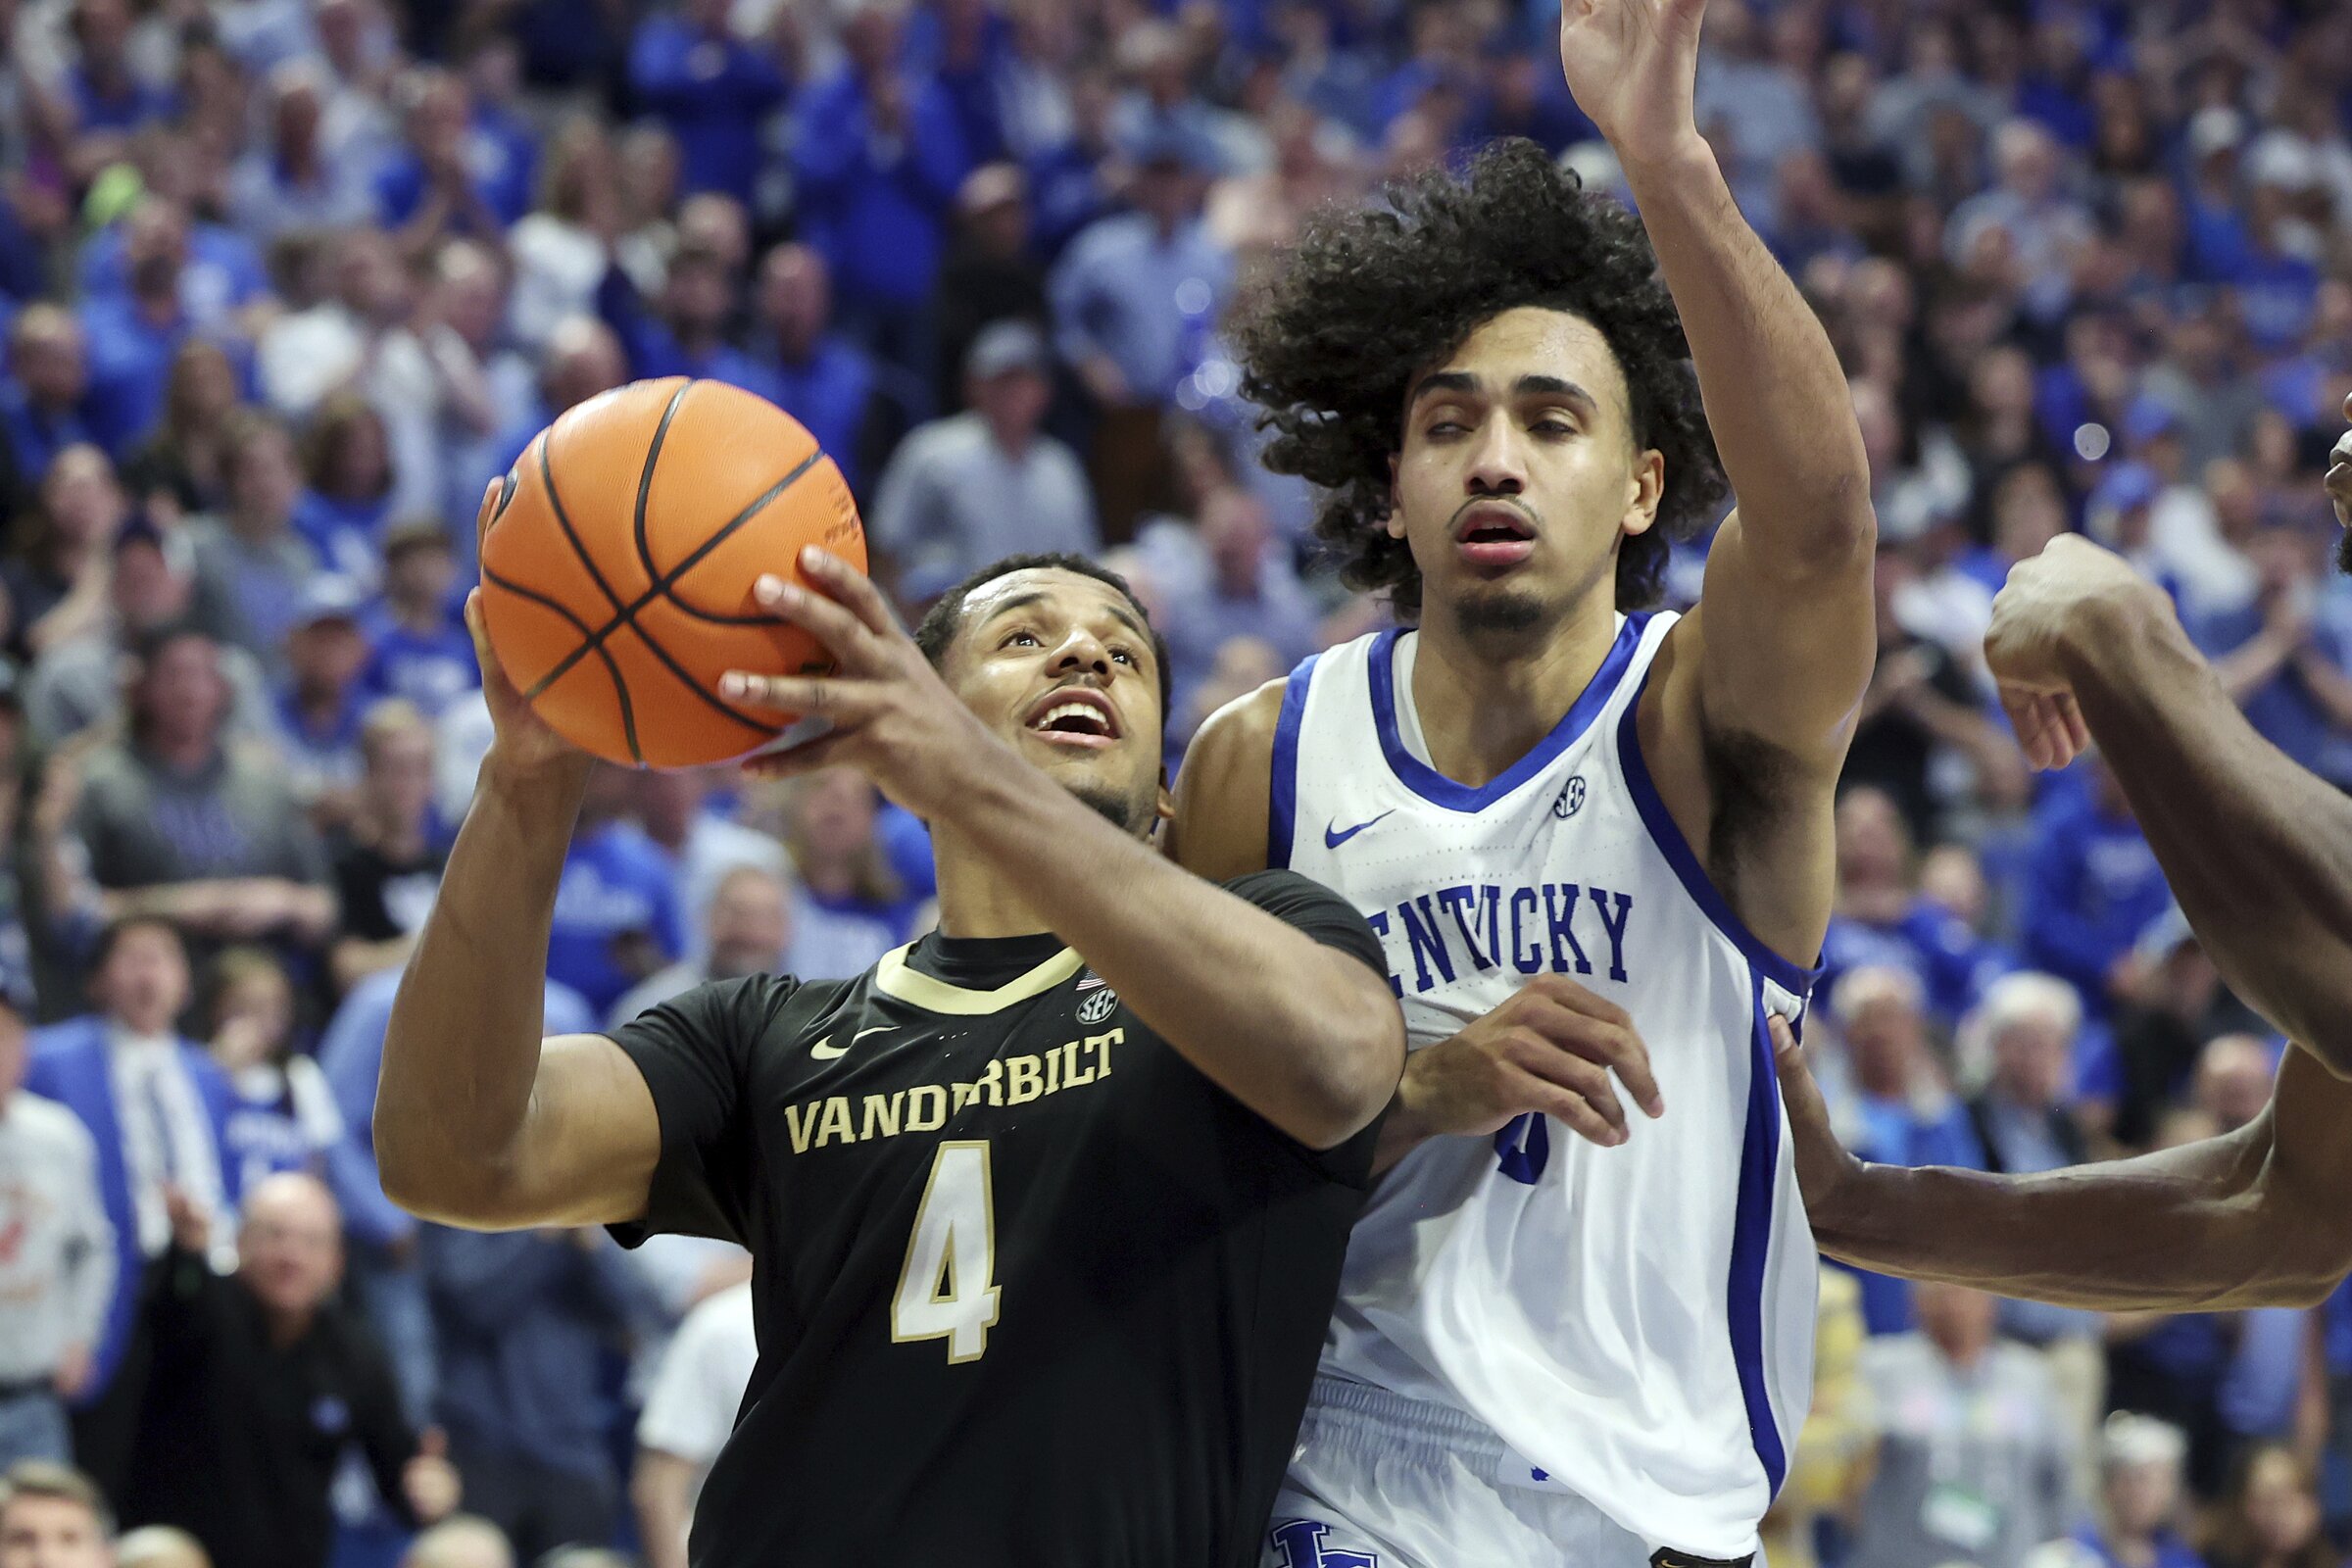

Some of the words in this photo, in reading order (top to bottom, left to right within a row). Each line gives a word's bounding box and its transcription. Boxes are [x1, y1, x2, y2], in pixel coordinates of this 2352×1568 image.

[1553, 776, 1586, 818] SEC
[1368, 883, 1632, 1000] NTUCKY
[1077, 987, 1119, 1024] SEC
[890, 1139, 1003, 1365] 4
